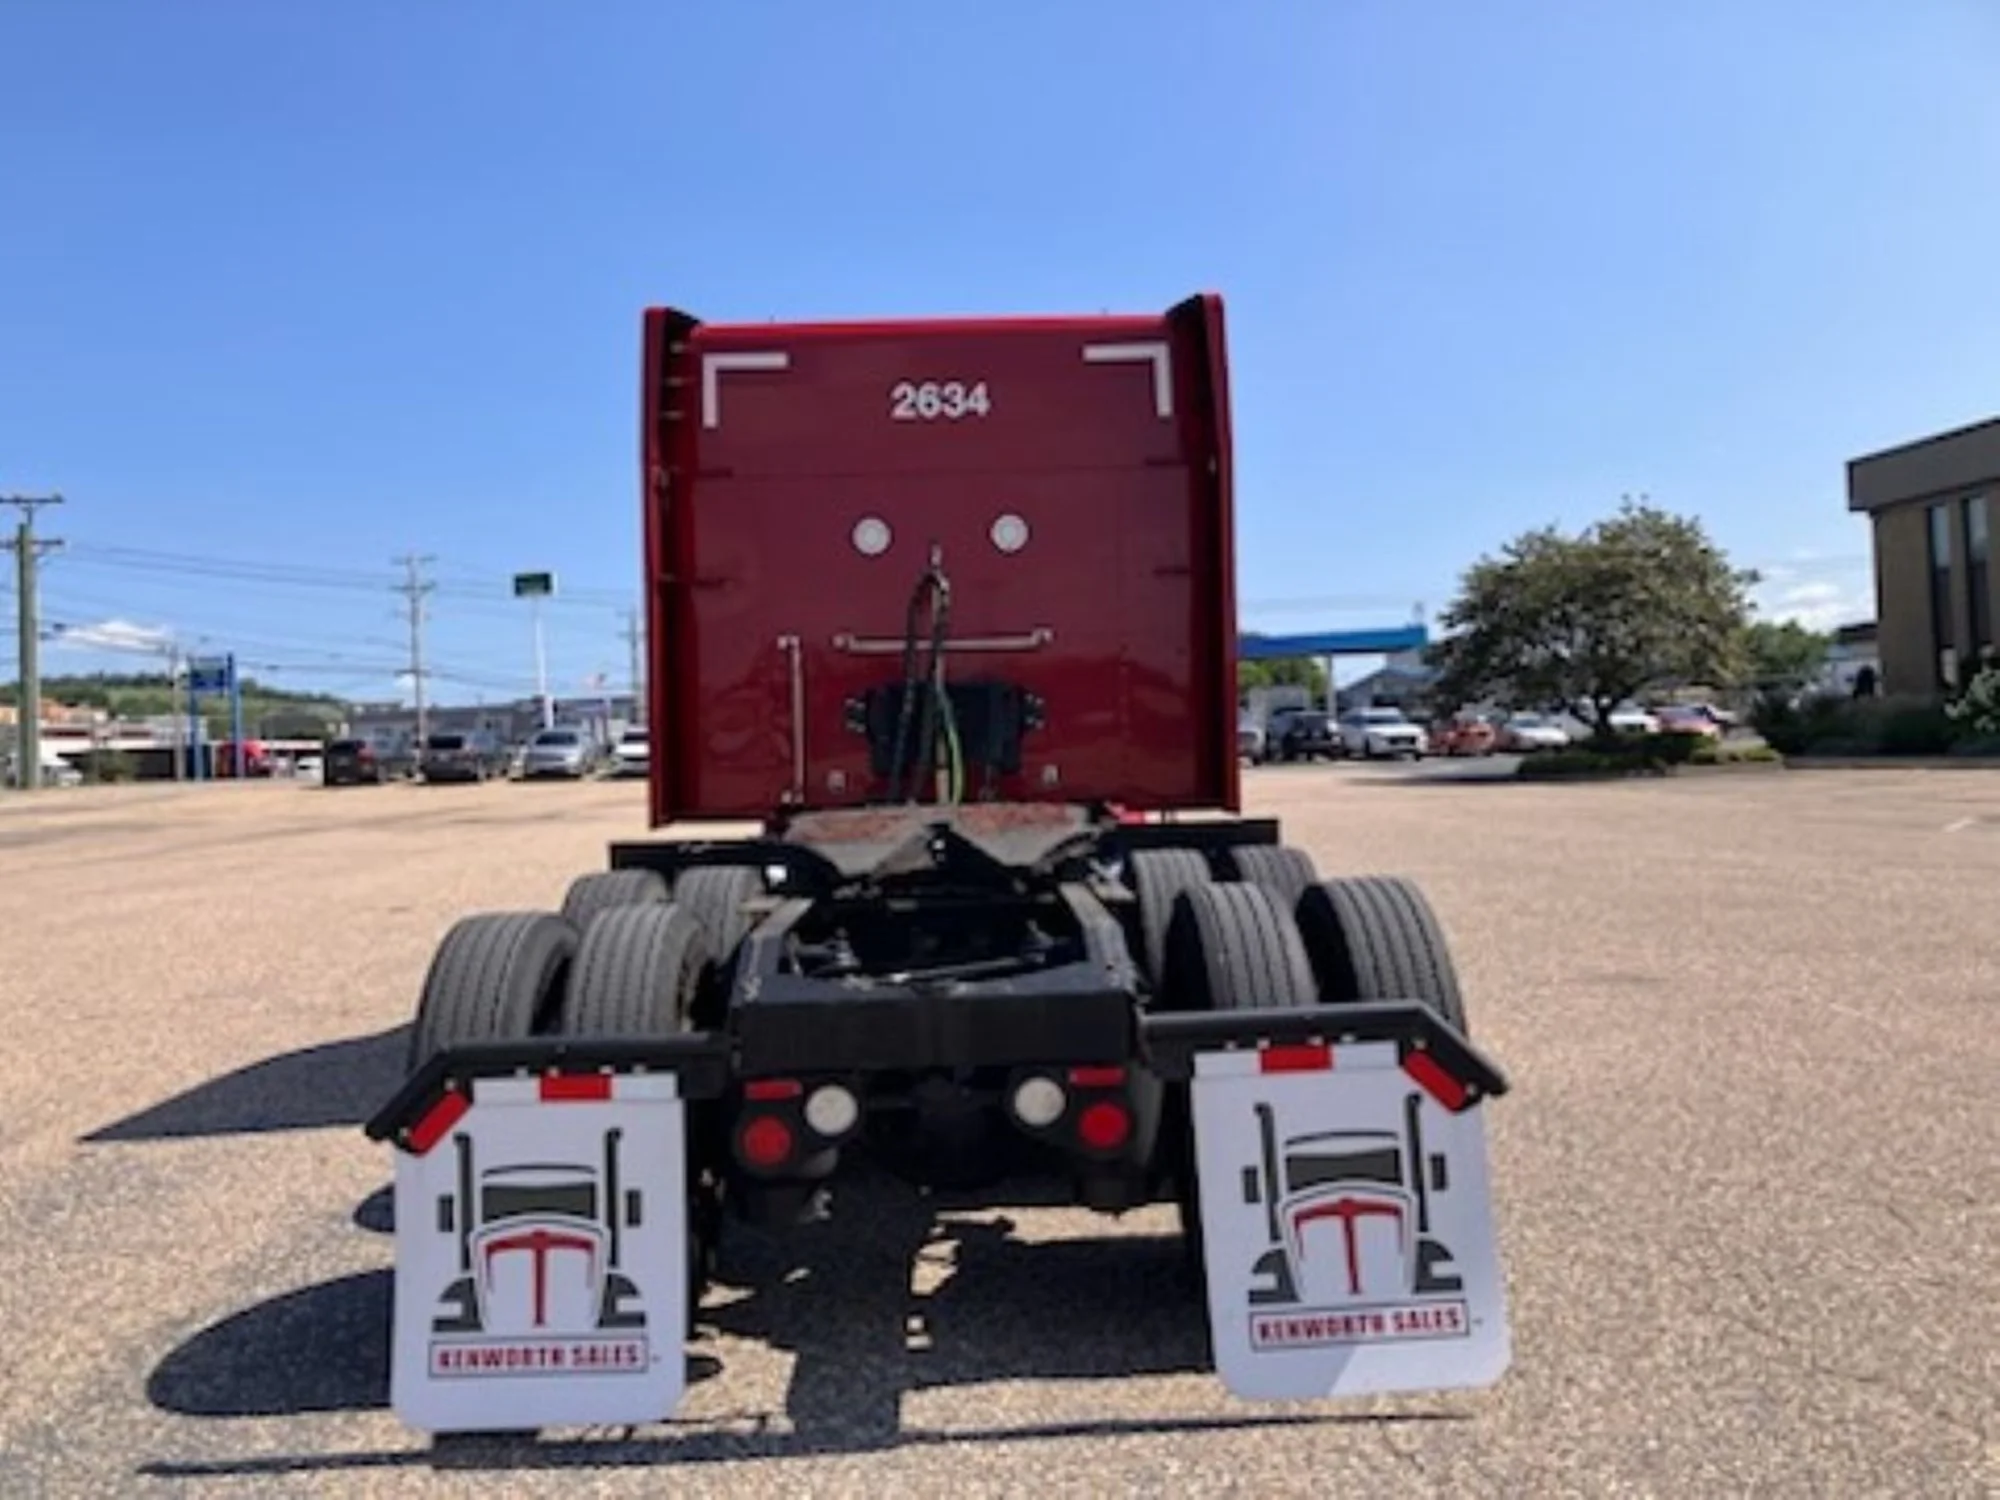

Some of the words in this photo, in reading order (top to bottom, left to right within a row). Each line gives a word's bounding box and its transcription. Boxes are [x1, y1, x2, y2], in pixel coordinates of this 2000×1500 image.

[892, 381, 990, 419] 2634
[1257, 1312, 1385, 1342] KENWORTH
[1393, 1306, 1461, 1335] SALES
[438, 1346, 567, 1371] KENWORTH
[572, 1343, 639, 1368] SALES
